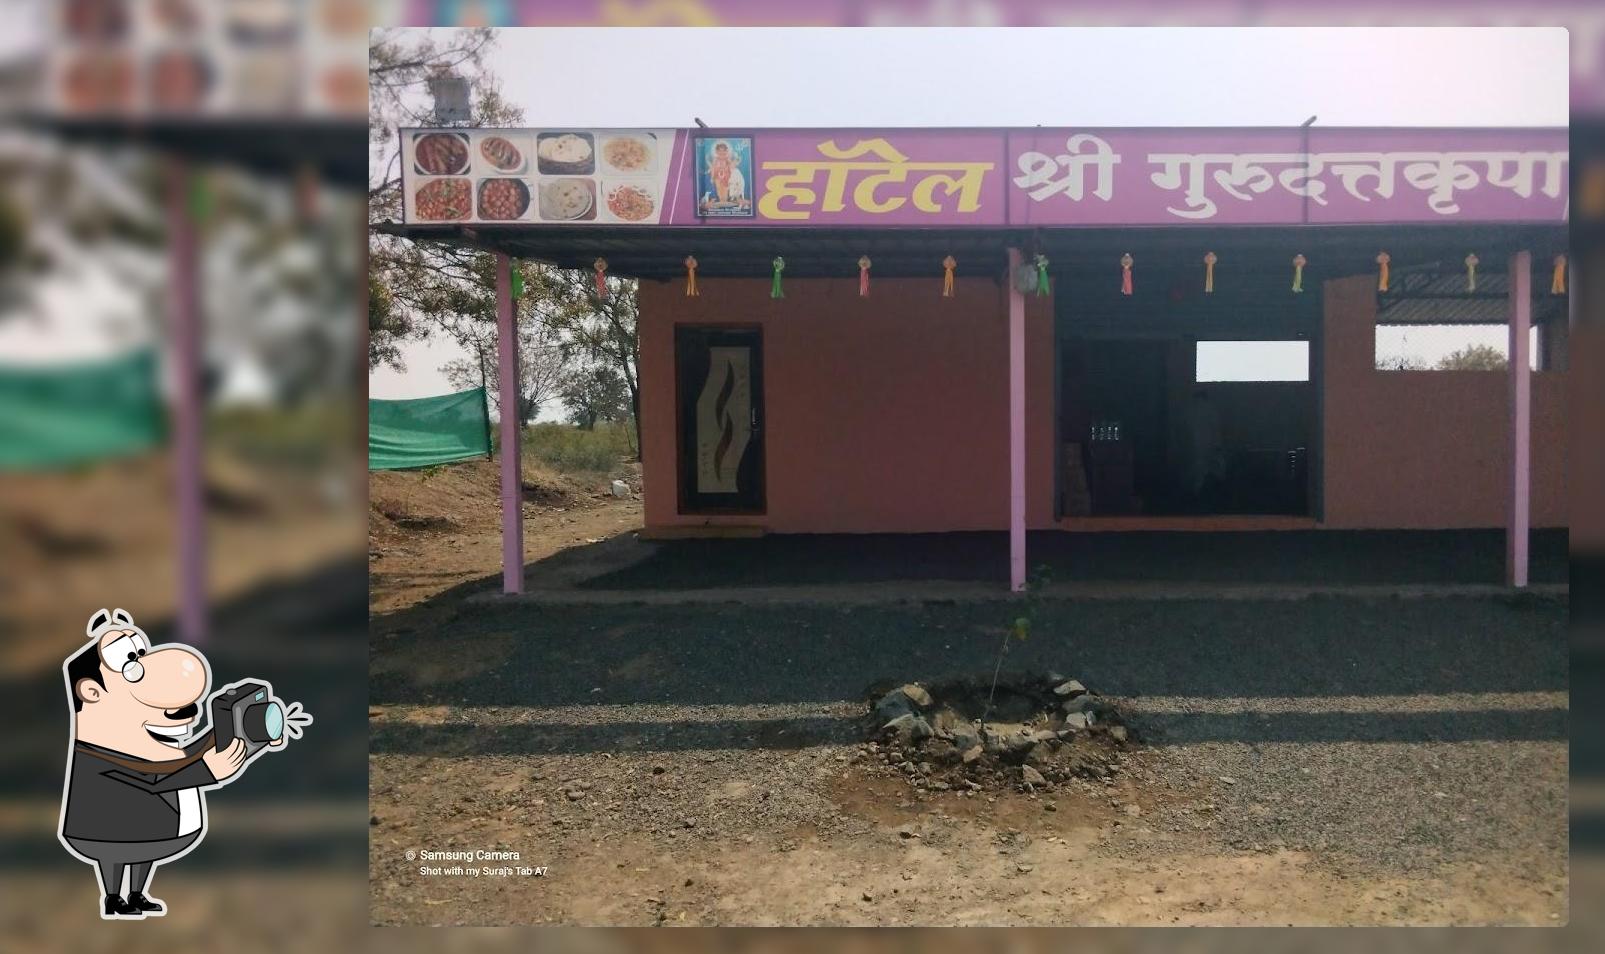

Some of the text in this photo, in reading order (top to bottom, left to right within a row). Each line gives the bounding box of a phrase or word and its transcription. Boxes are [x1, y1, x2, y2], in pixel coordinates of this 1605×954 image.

[757, 133, 1569, 220] हॉटेल श्री गुरुदत्तकृपा
